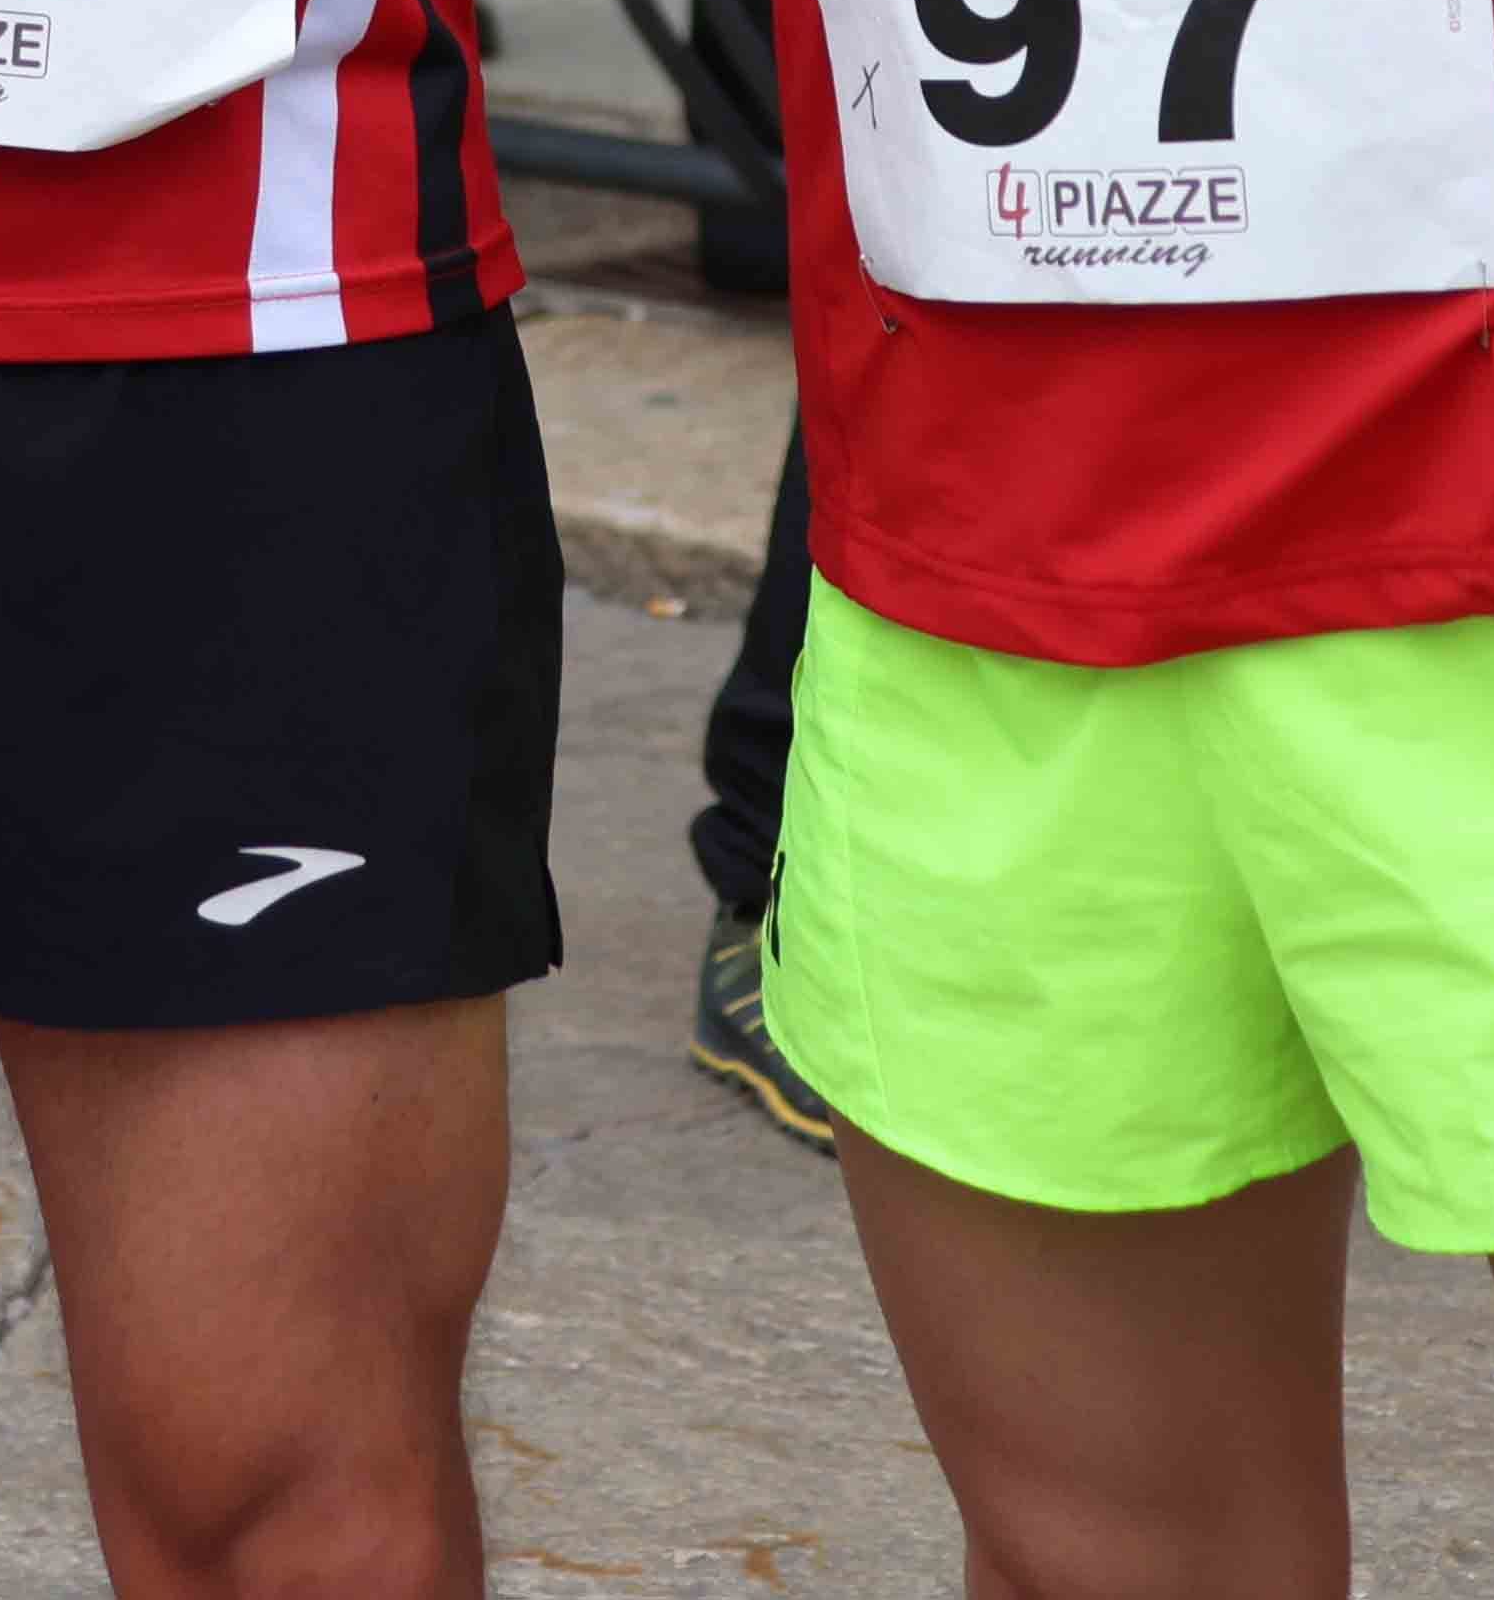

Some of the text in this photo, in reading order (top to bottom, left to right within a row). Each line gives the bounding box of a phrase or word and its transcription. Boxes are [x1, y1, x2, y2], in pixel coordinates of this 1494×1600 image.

[995, 161, 1245, 240] 4 PIAZZE
[1023, 237, 1211, 276] running
